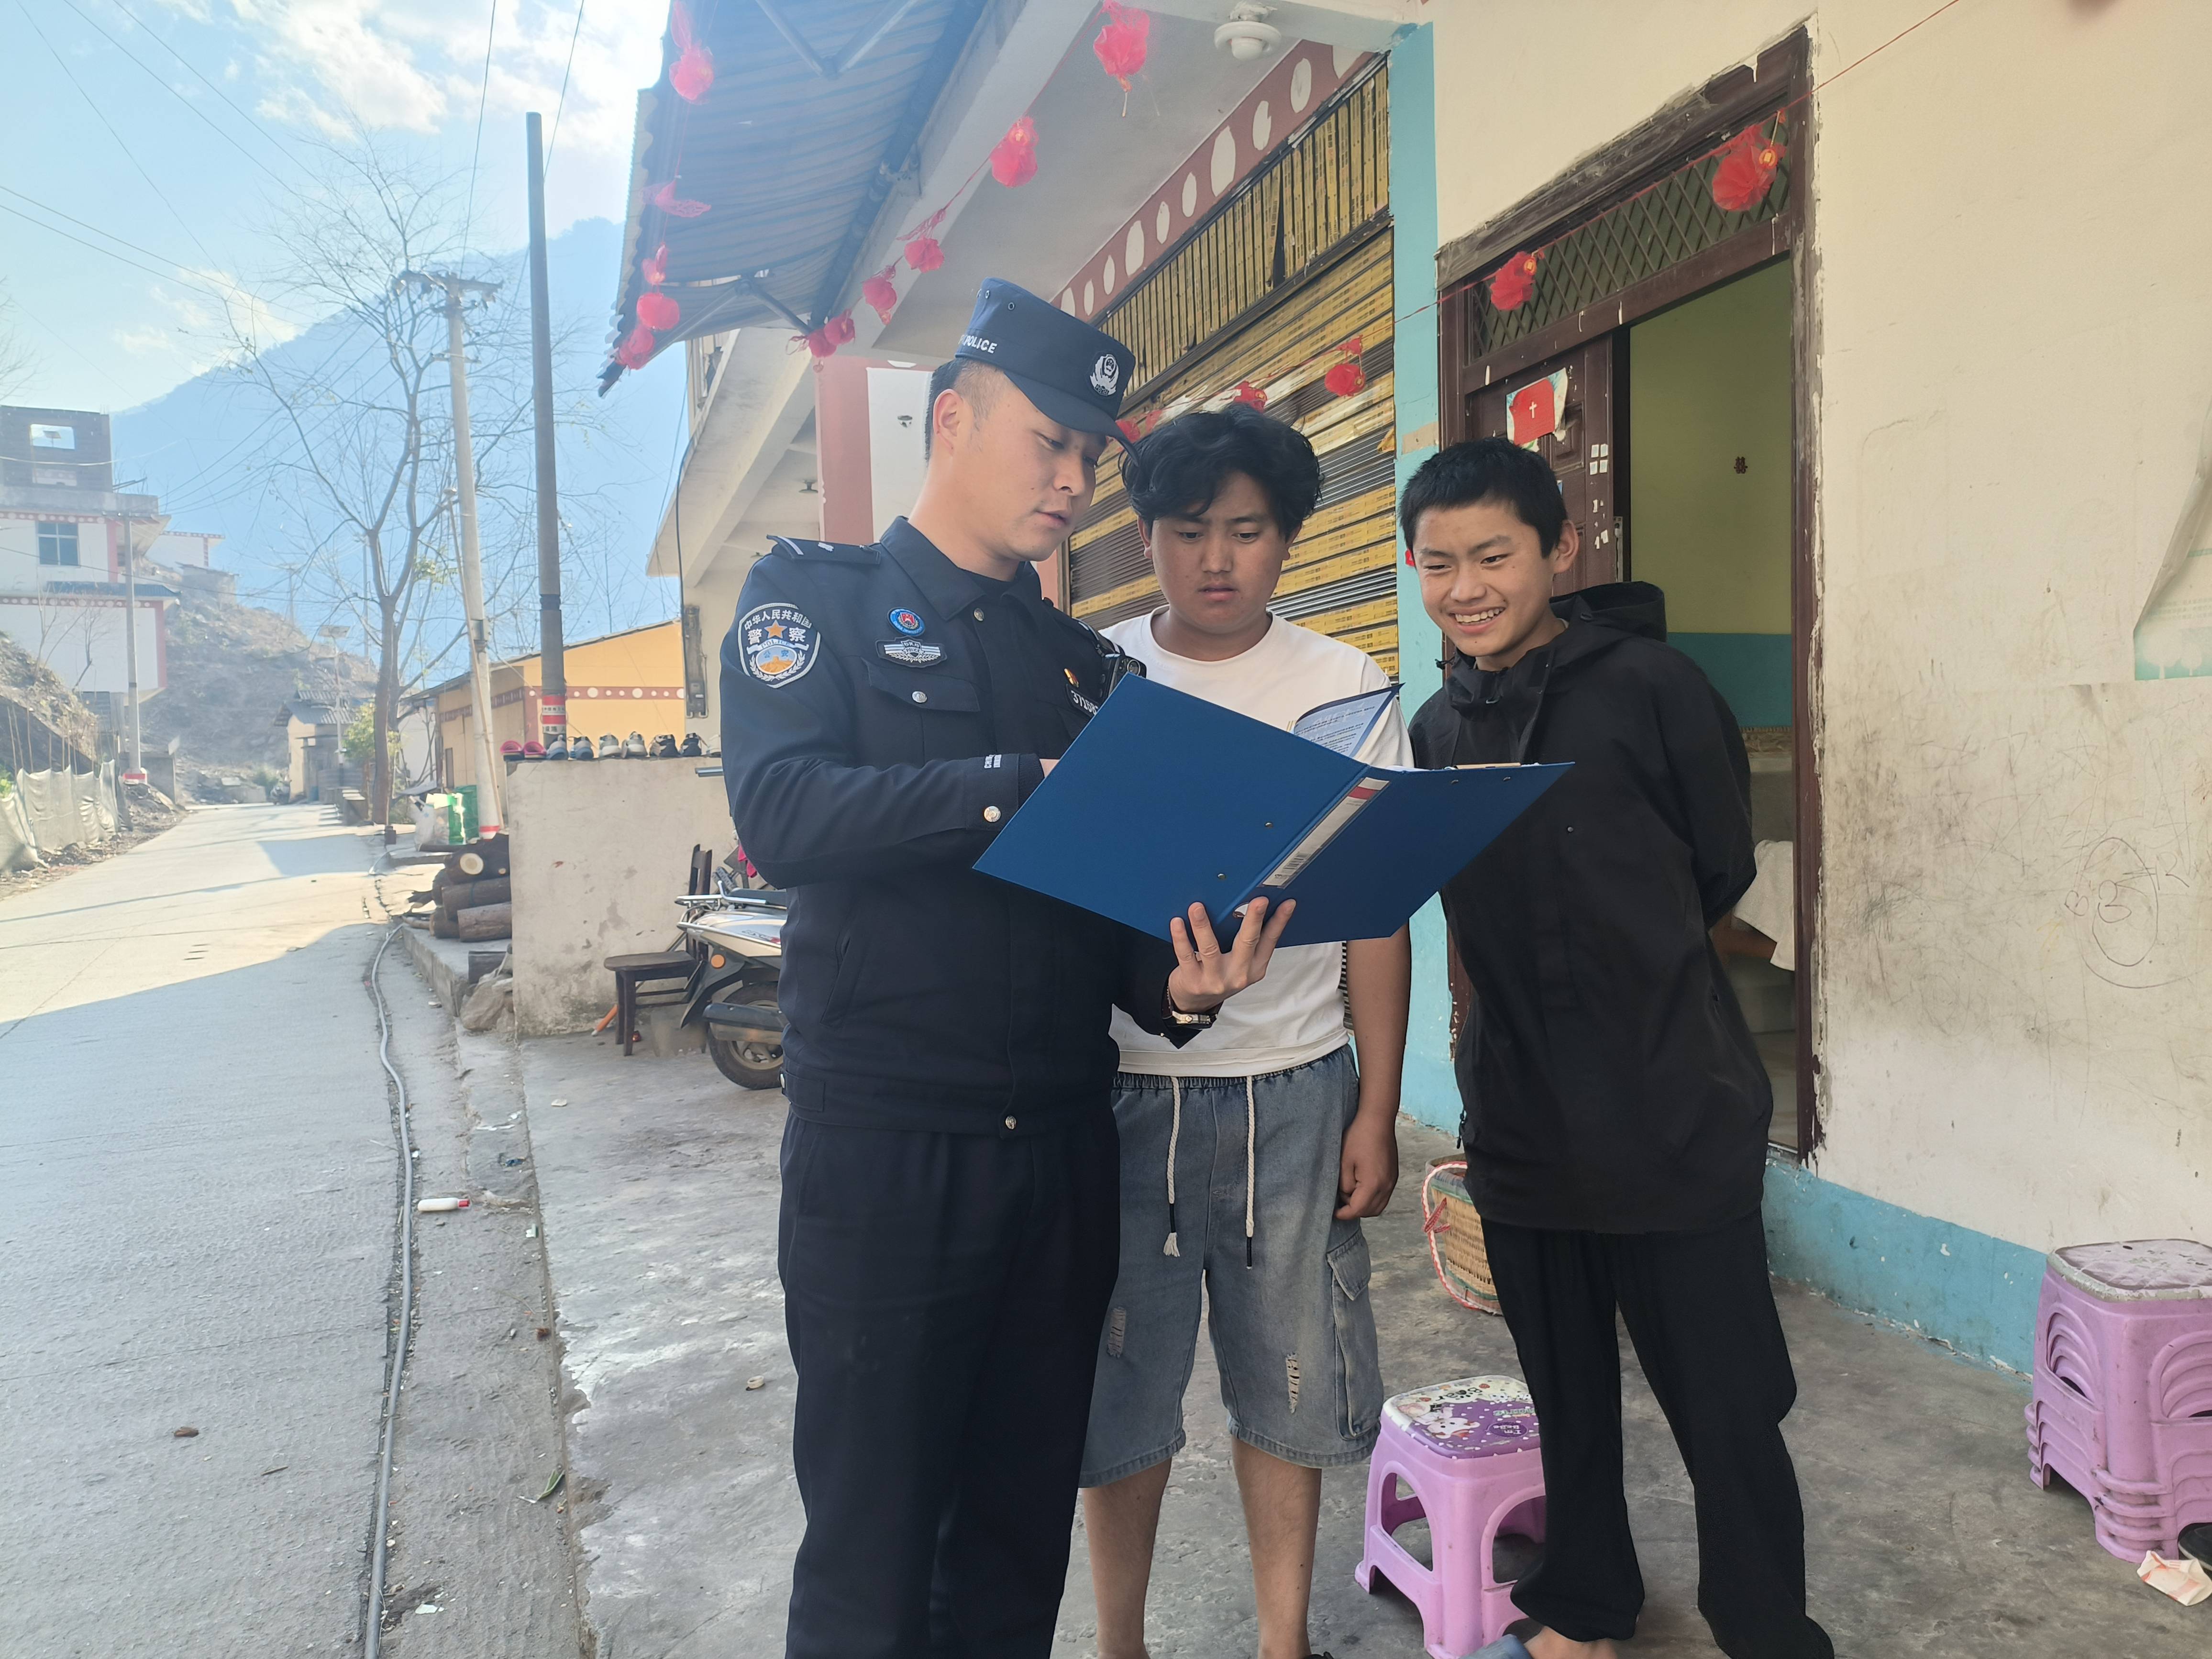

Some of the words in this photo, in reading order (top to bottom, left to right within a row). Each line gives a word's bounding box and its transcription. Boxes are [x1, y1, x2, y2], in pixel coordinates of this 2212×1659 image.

[962, 335, 998, 354] POLICE
[744, 609, 812, 631] 中华人民共和国
[761, 639, 790, 649] POLICE
